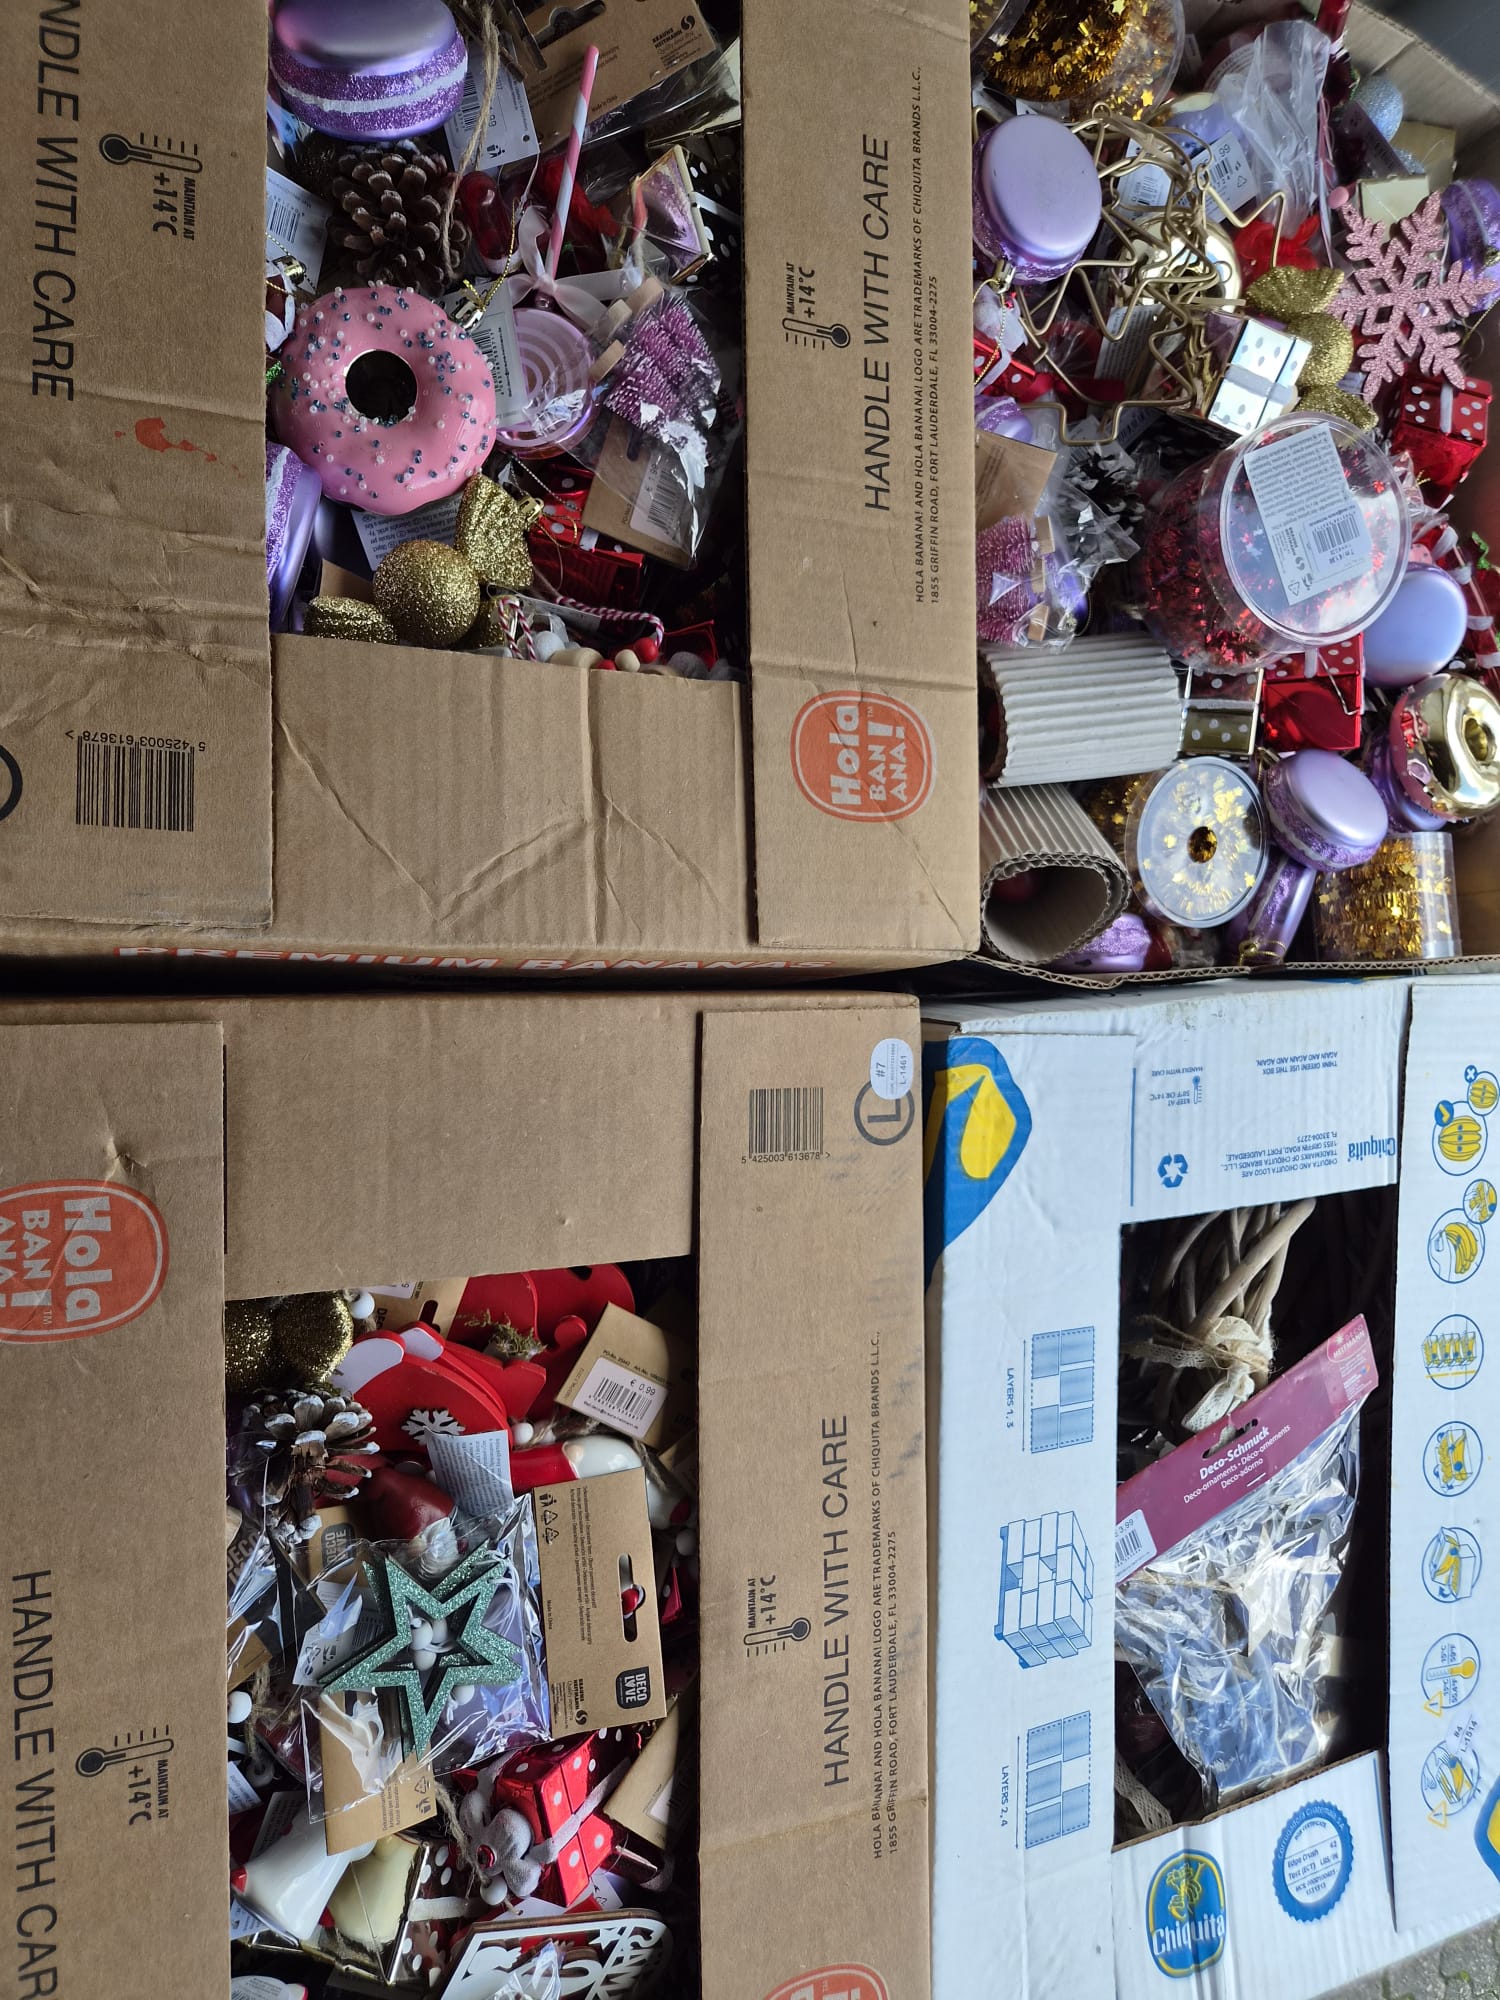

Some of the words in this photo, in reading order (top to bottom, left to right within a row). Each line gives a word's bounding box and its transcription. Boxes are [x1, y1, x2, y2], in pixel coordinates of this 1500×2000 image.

[911, 104, 921, 154] BRANDS
[35, 136, 78, 256] WITH
[153, 172, 178, 236] +14°C
[184, 177, 196, 225] MAINTAIN
[862, 133, 889, 241] CARE
[911, 156, 922, 215] CHIQUITA
[183, 227, 196, 241] AT
[912, 217, 921, 234] OF
[786, 262, 795, 273] AT
[912, 237, 922, 319] TRADEMARKS
[786, 274, 795, 315] MAINTAIN
[799, 266, 815, 318] +14°C
[863, 250, 889, 345] WITH
[928, 276, 937, 346] 33004-2275
[32, 269, 76, 401] CARE
[913, 321, 922, 345] ARE
[913, 349, 923, 382] LOGO
[928, 349, 938, 362] FL
[929, 366, 940, 448] LAUDERDALE,
[864, 357, 890, 512] HANDLE
[914, 444, 923, 478] HOLA
[929, 451, 939, 482] FORT
[914, 481, 923, 507] AND
[930, 485, 940, 523] ROAD,
[930, 526, 939, 573] GRIFFIN
[915, 570, 924, 603] HOLA
[930, 576, 939, 604] 1855
[82, 730, 134, 745] 613678
[140, 736, 190, 750] 425003
[829, 705, 862, 805] Hola
[1264, 1156, 1291, 1165] CHIQUITA
[1300, 1162, 1311, 1170] AND
[1348, 1136, 1396, 1161] Chiquita
[1254, 1168, 1270, 1176] LOGO
[1272, 1164, 1298, 1173] CHIQUITA
[64, 1195, 113, 1322] Hola
[628, 1377, 637, 1387] €
[637, 1381, 656, 1397] 0.99
[870, 1369, 880, 1417] BRANDS
[1007, 1367, 1015, 1406] LAYERS
[821, 1415, 848, 1518] CARE
[871, 1420, 881, 1477] CHIQUITA
[1199, 1426, 1270, 1480] Deco-Schmuck
[871, 1481, 880, 1497] OF
[1183, 1464, 1238, 1503] Deco-ornaments
[1220, 1458, 1264, 1489] Deco-adorno
[871, 1500, 881, 1580] TRADEMARKS
[747, 1578, 756, 1587] AT
[823, 1529, 849, 1627] WITH
[887, 1531, 897, 1600] 33004-2275
[747, 1589, 756, 1629] MAINTAIN
[759, 1575, 776, 1625] +14°C
[872, 1583, 882, 1606] ARE
[887, 1602, 897, 1617] FL
[872, 1610, 882, 1644] LOGO
[12, 1570, 55, 1761] HANDLE
[887, 1620, 898, 1701] LAUDERDALE,
[633, 1673, 648, 1701] DECO
[823, 1635, 849, 1787] HANDLE
[872, 1704, 882, 1738] HOLA
[887, 1706, 897, 1736] FORT
[872, 1741, 882, 1763] AND
[887, 1739, 898, 1776] ROAD,
[128, 1765, 152, 1826] +14°C
[157, 1759, 169, 1806] MAINTAIN
[1001, 1765, 1009, 1805] LAYERS
[15, 1768, 56, 1893] WITH
[158, 1808, 169, 1819] AT
[872, 1824, 881, 1859] HOLA
[887, 1826, 897, 1854] 1855
[1152, 1913, 1225, 1955] Chiquita
